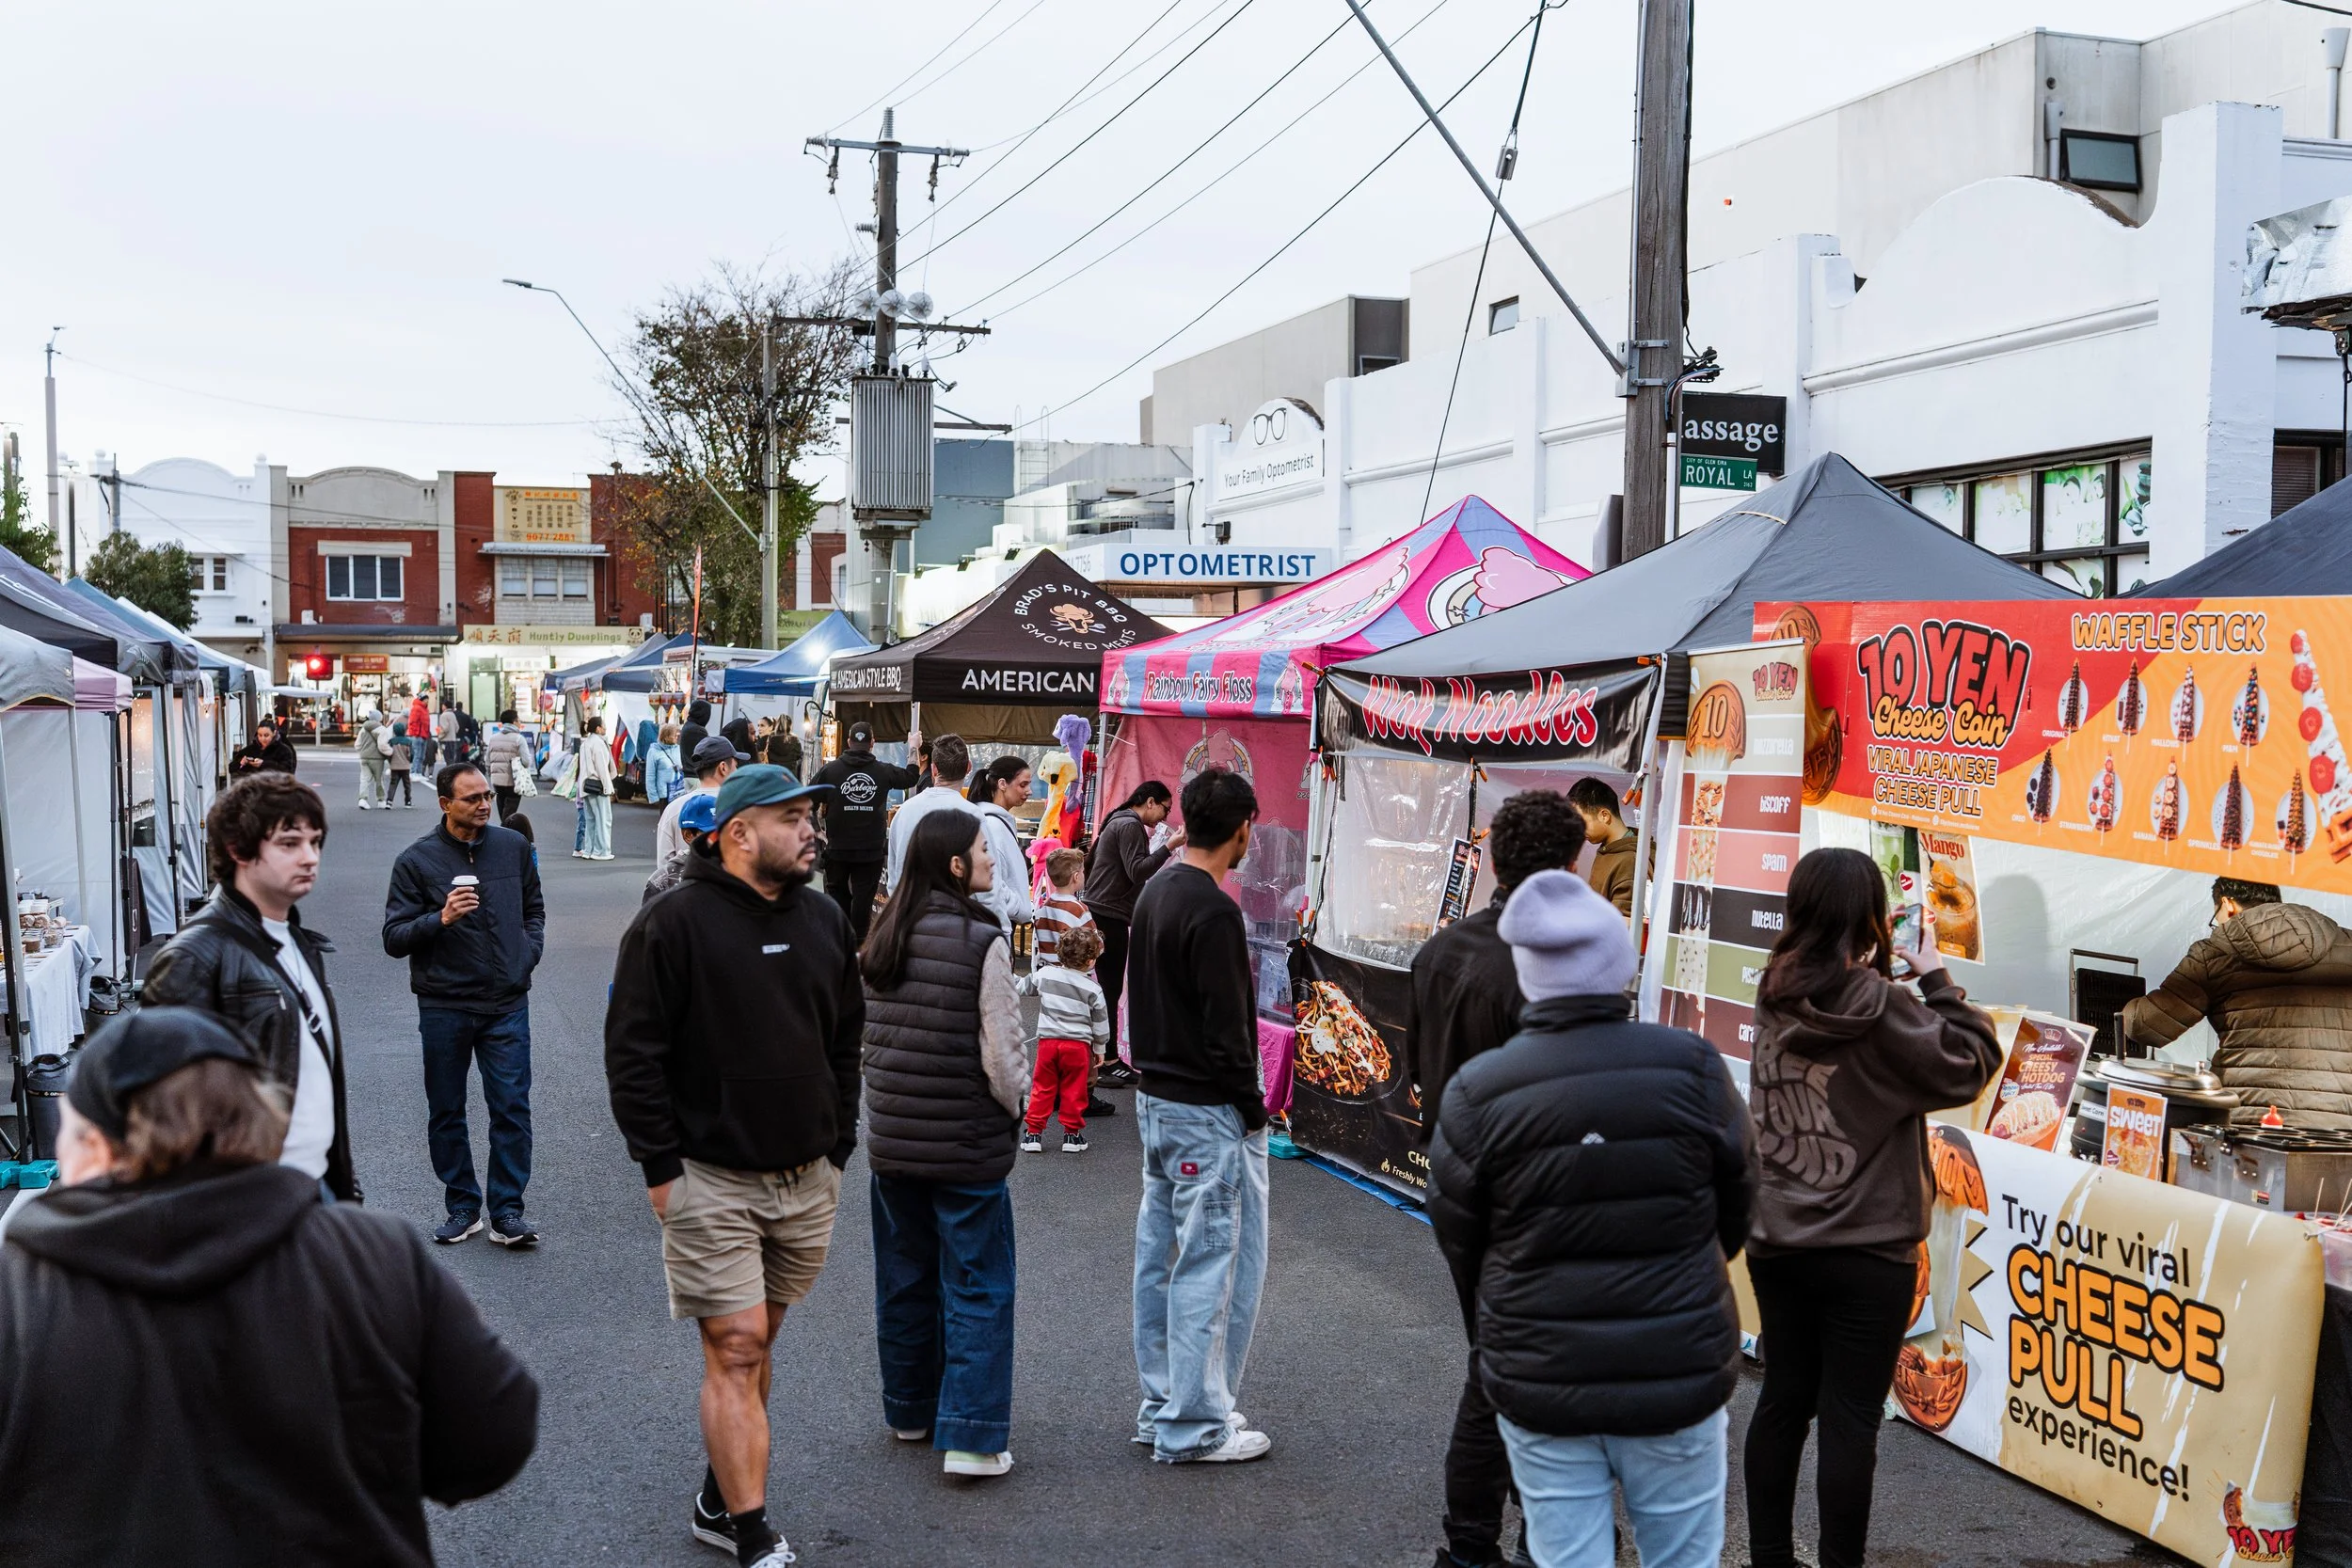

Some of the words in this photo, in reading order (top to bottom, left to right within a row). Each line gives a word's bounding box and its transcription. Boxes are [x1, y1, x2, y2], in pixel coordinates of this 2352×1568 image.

[1681, 411, 1778, 451] assage
[1224, 473, 1240, 488] Your
[1242, 469, 1265, 484] Family
[1266, 453, 1314, 482] Optometrist
[1685, 465, 1736, 486] ROYAL
[1743, 469, 1753, 479] LA
[1120, 552, 1316, 578] OPTOMETRIST
[1014, 583, 1057, 616] BRAD'S
[1063, 585, 1091, 599] PIT
[1095, 599, 1128, 624] BBQ
[529, 631, 564, 642] Huntly
[1021, 623, 1098, 650] SMOKED
[1102, 628, 1136, 650] MEATS
[2073, 613, 2176, 651] WAFFLE
[2180, 612, 2266, 654] STICK
[837, 668, 865, 689] AMERICAN
[866, 667, 886, 689] STYLE
[886, 666, 901, 691] BBQ
[961, 669, 1095, 693] AMERICAN
[1144, 672, 1189, 702] Rainbow
[1191, 671, 1220, 703] Fairy
[1222, 671, 1253, 704] Floss
[1770, 661, 1799, 695] YEN
[1858, 625, 1917, 721] 10
[1921, 619, 2031, 734] YEN
[1362, 674, 1434, 756] Wok
[1435, 669, 1598, 748] Noodles
[1874, 695, 1947, 739] Cheese
[1952, 699, 2008, 748] Coin
[2042, 729, 2066, 737] ORIGINAL
[1868, 746, 1911, 775] VIRAL
[1913, 751, 1997, 786] JAPANESE
[1875, 777, 1938, 809] CHEESE
[1939, 784, 1982, 817] PULL
[1921, 832, 1965, 861] Mango
[2018, 1061, 2058, 1073] CHEESY
[2020, 1072, 2066, 1083] HOTDOG
[1392, 1165, 1416, 1184] Freshly
[2001, 1193, 2044, 1249] Try
[2056, 1222, 2110, 1259] our
[2117, 1233, 2190, 1288] viral
[2006, 1242, 2224, 1393] CHEESE
[2009, 1315, 2143, 1442] PULL
[2008, 1399, 2190, 1502] experience!
